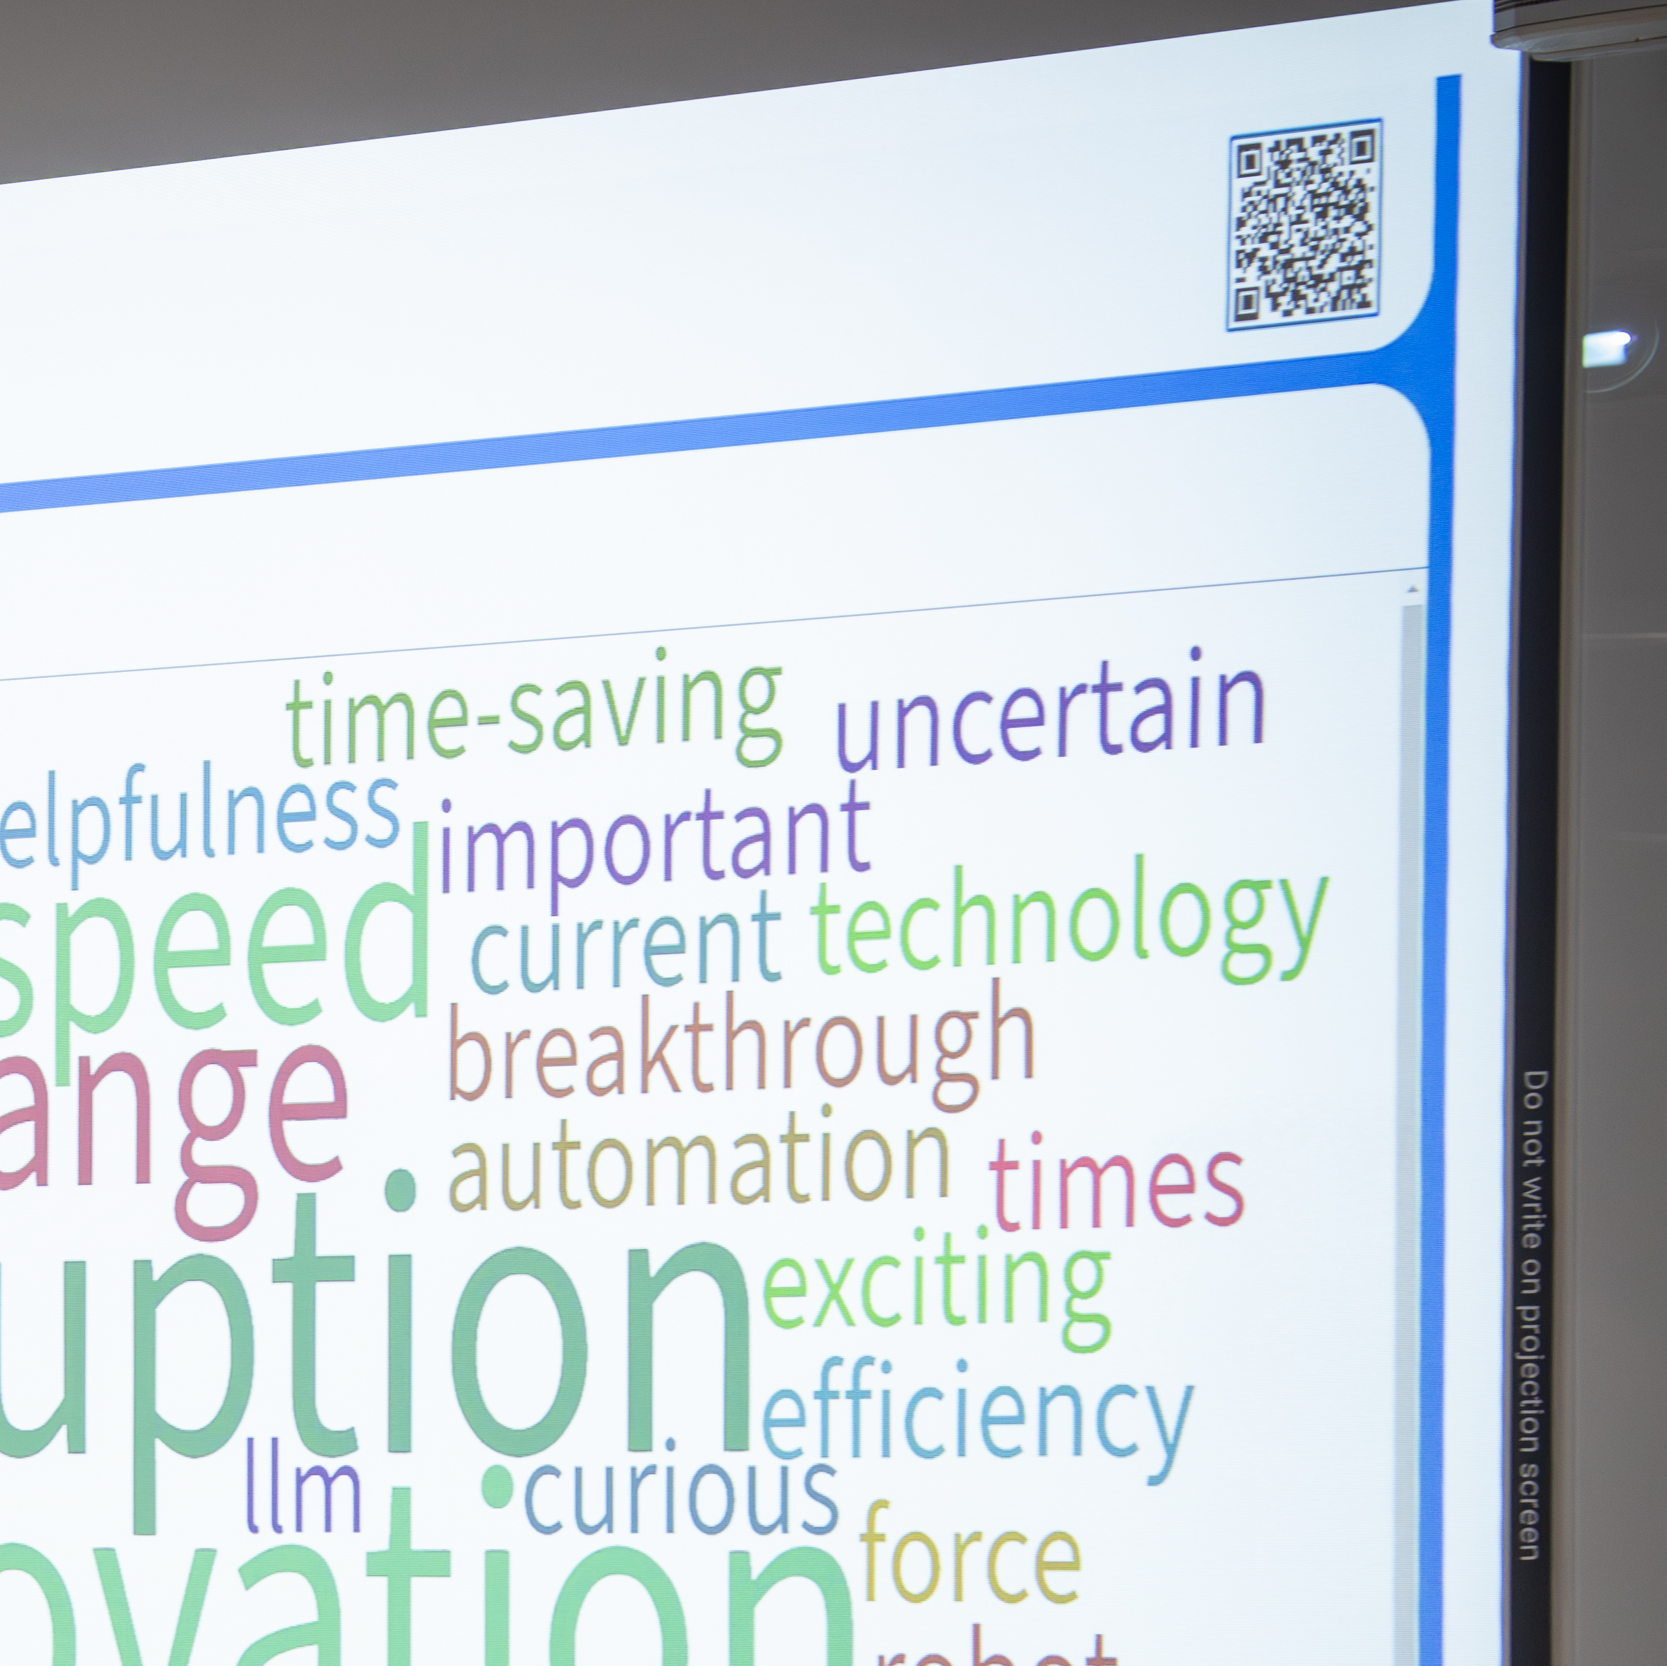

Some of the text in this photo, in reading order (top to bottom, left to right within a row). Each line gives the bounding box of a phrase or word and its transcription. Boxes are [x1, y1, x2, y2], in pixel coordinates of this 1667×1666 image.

[285, 645, 783, 769] time-saving
[837, 644, 1265, 774] uncertain
[441, 778, 871, 917] important
[470, 889, 782, 994] current
[809, 852, 1331, 986] technology
[449, 977, 1034, 1118] breakthrough
[449, 1102, 949, 1213] automation
[988, 1130, 1245, 1232] times
[763, 1224, 1112, 1354] exciting
[1515, 1070, 1549, 1561] Do not write on projection screen
[762, 1355, 1195, 1487] efficiency
[246, 1436, 361, 1534] llm
[524, 1437, 839, 1536] curious
[859, 1499, 1082, 1605] force
